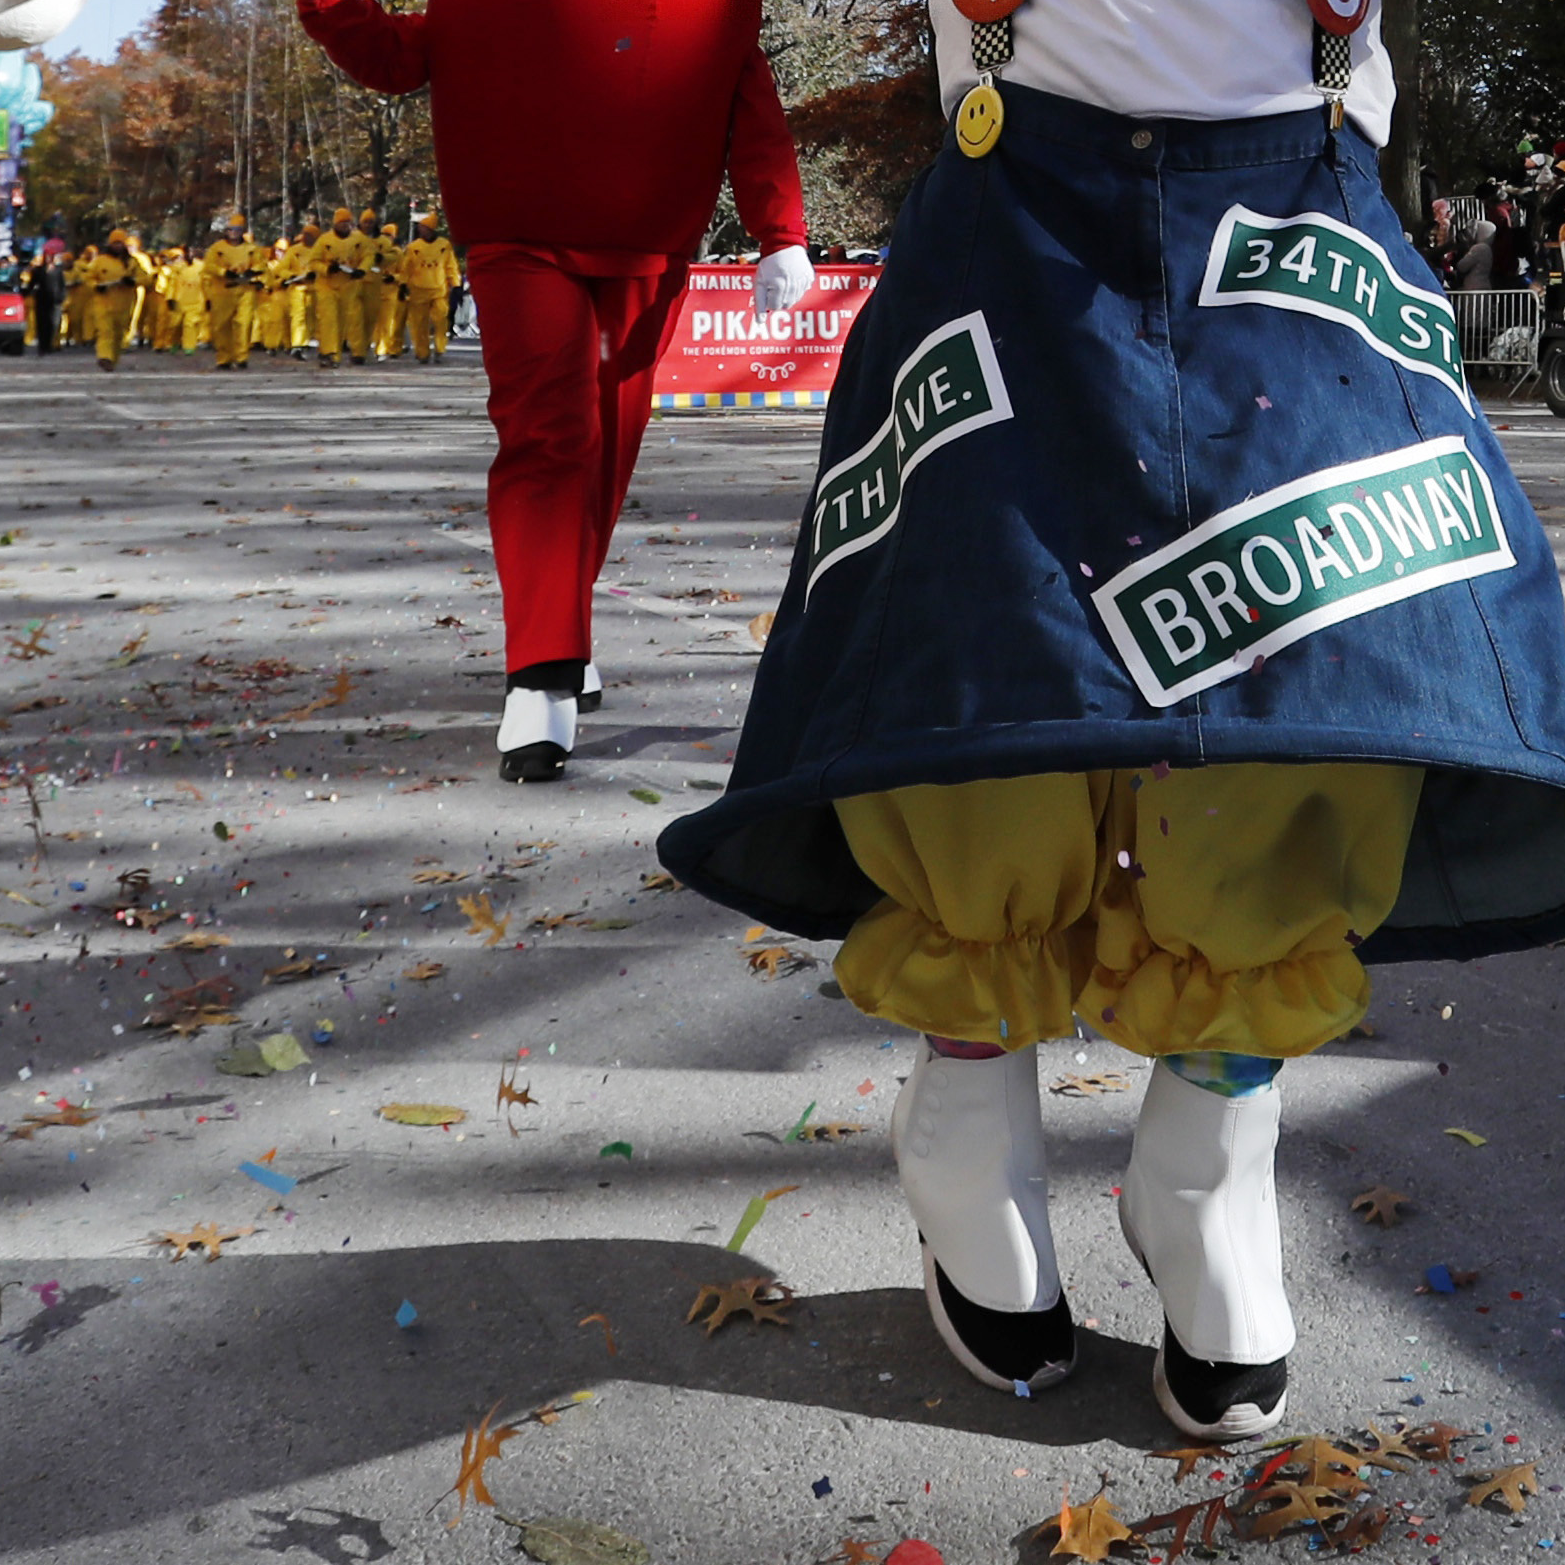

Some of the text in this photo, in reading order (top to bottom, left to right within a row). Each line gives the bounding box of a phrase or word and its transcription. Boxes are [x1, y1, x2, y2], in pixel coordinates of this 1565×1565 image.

[819, 275, 850, 291] DAY
[1237, 236, 1460, 373] 34TH ST.
[683, 347, 700, 356] THE
[703, 344, 746, 356] POKÉMON
[749, 346, 791, 355] COMPANY
[812, 467, 886, 555] 7TH
[1140, 468, 1483, 666] BROADWAY
